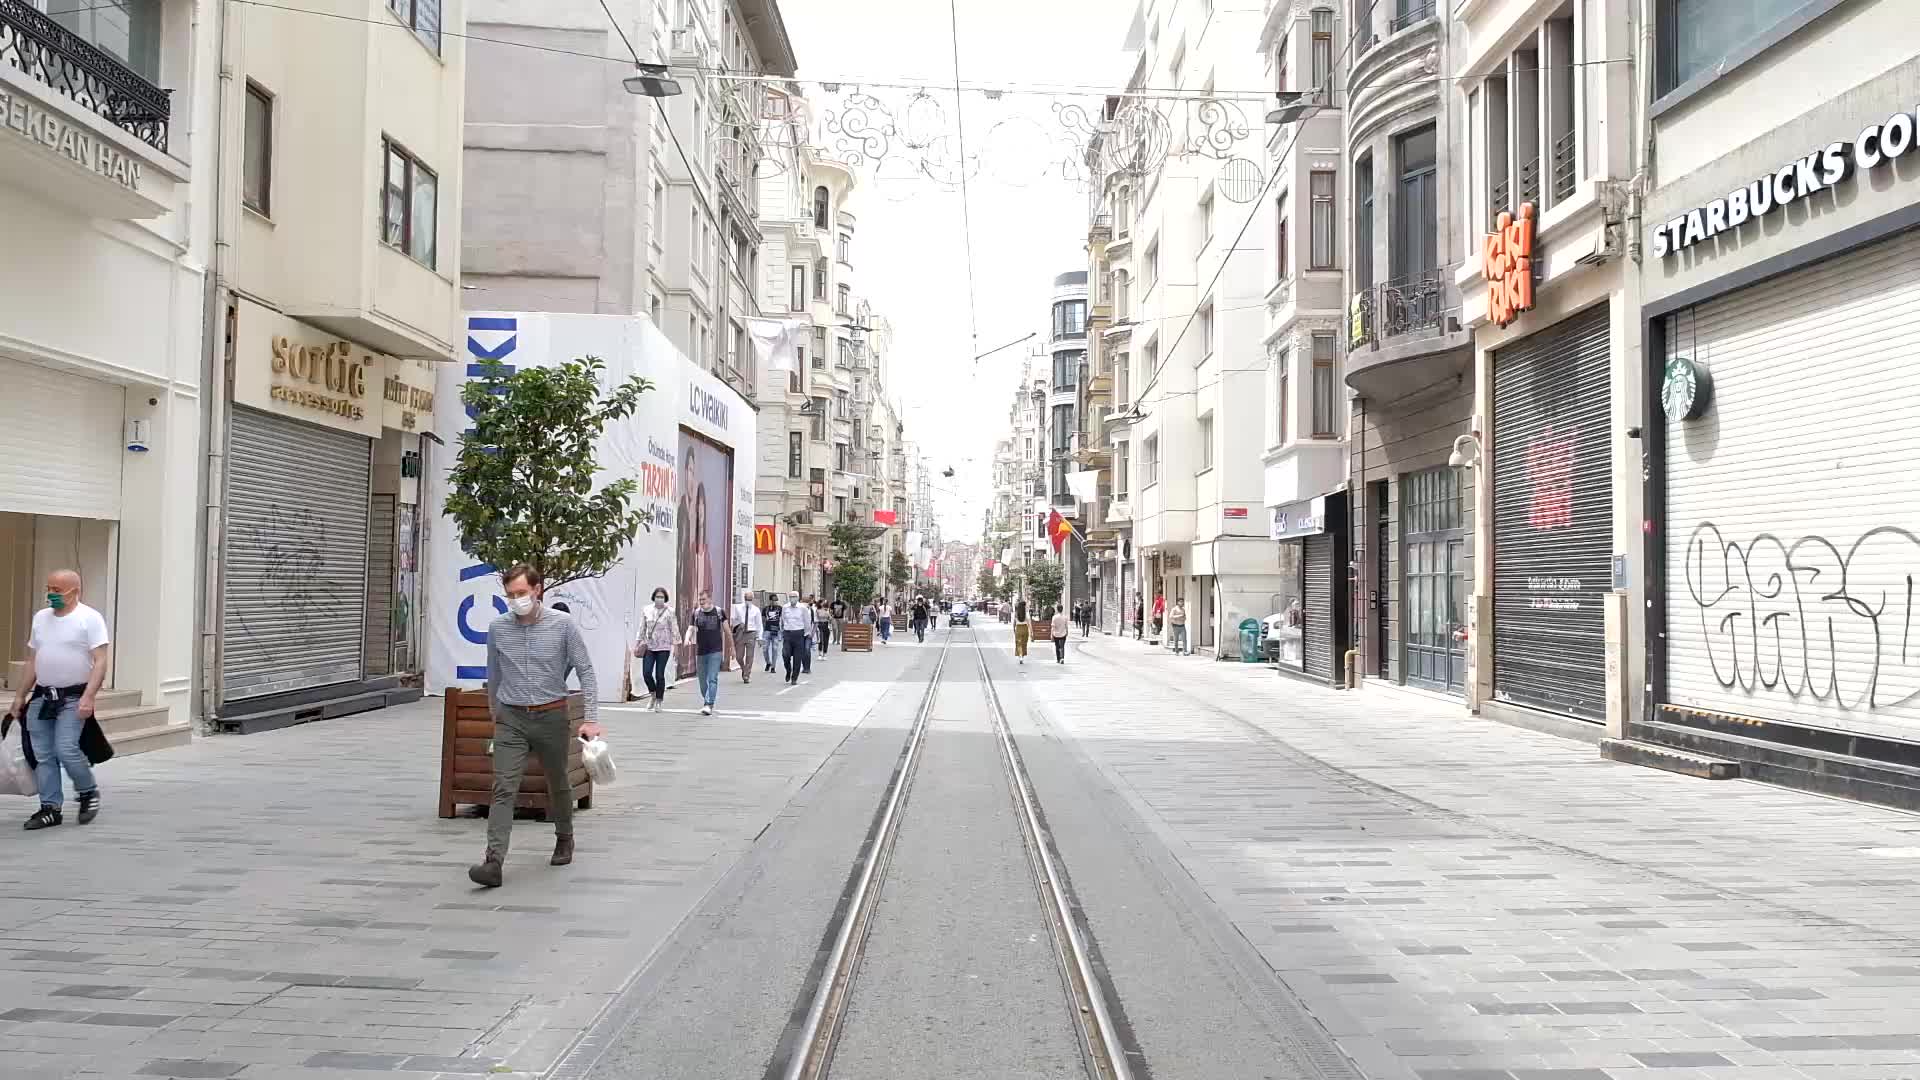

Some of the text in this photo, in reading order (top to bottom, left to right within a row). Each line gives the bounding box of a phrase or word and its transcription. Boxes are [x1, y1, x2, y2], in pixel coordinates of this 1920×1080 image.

[95, 143, 140, 191] HAN
[1653, 104, 1920, 259] STARBUCKS CO
